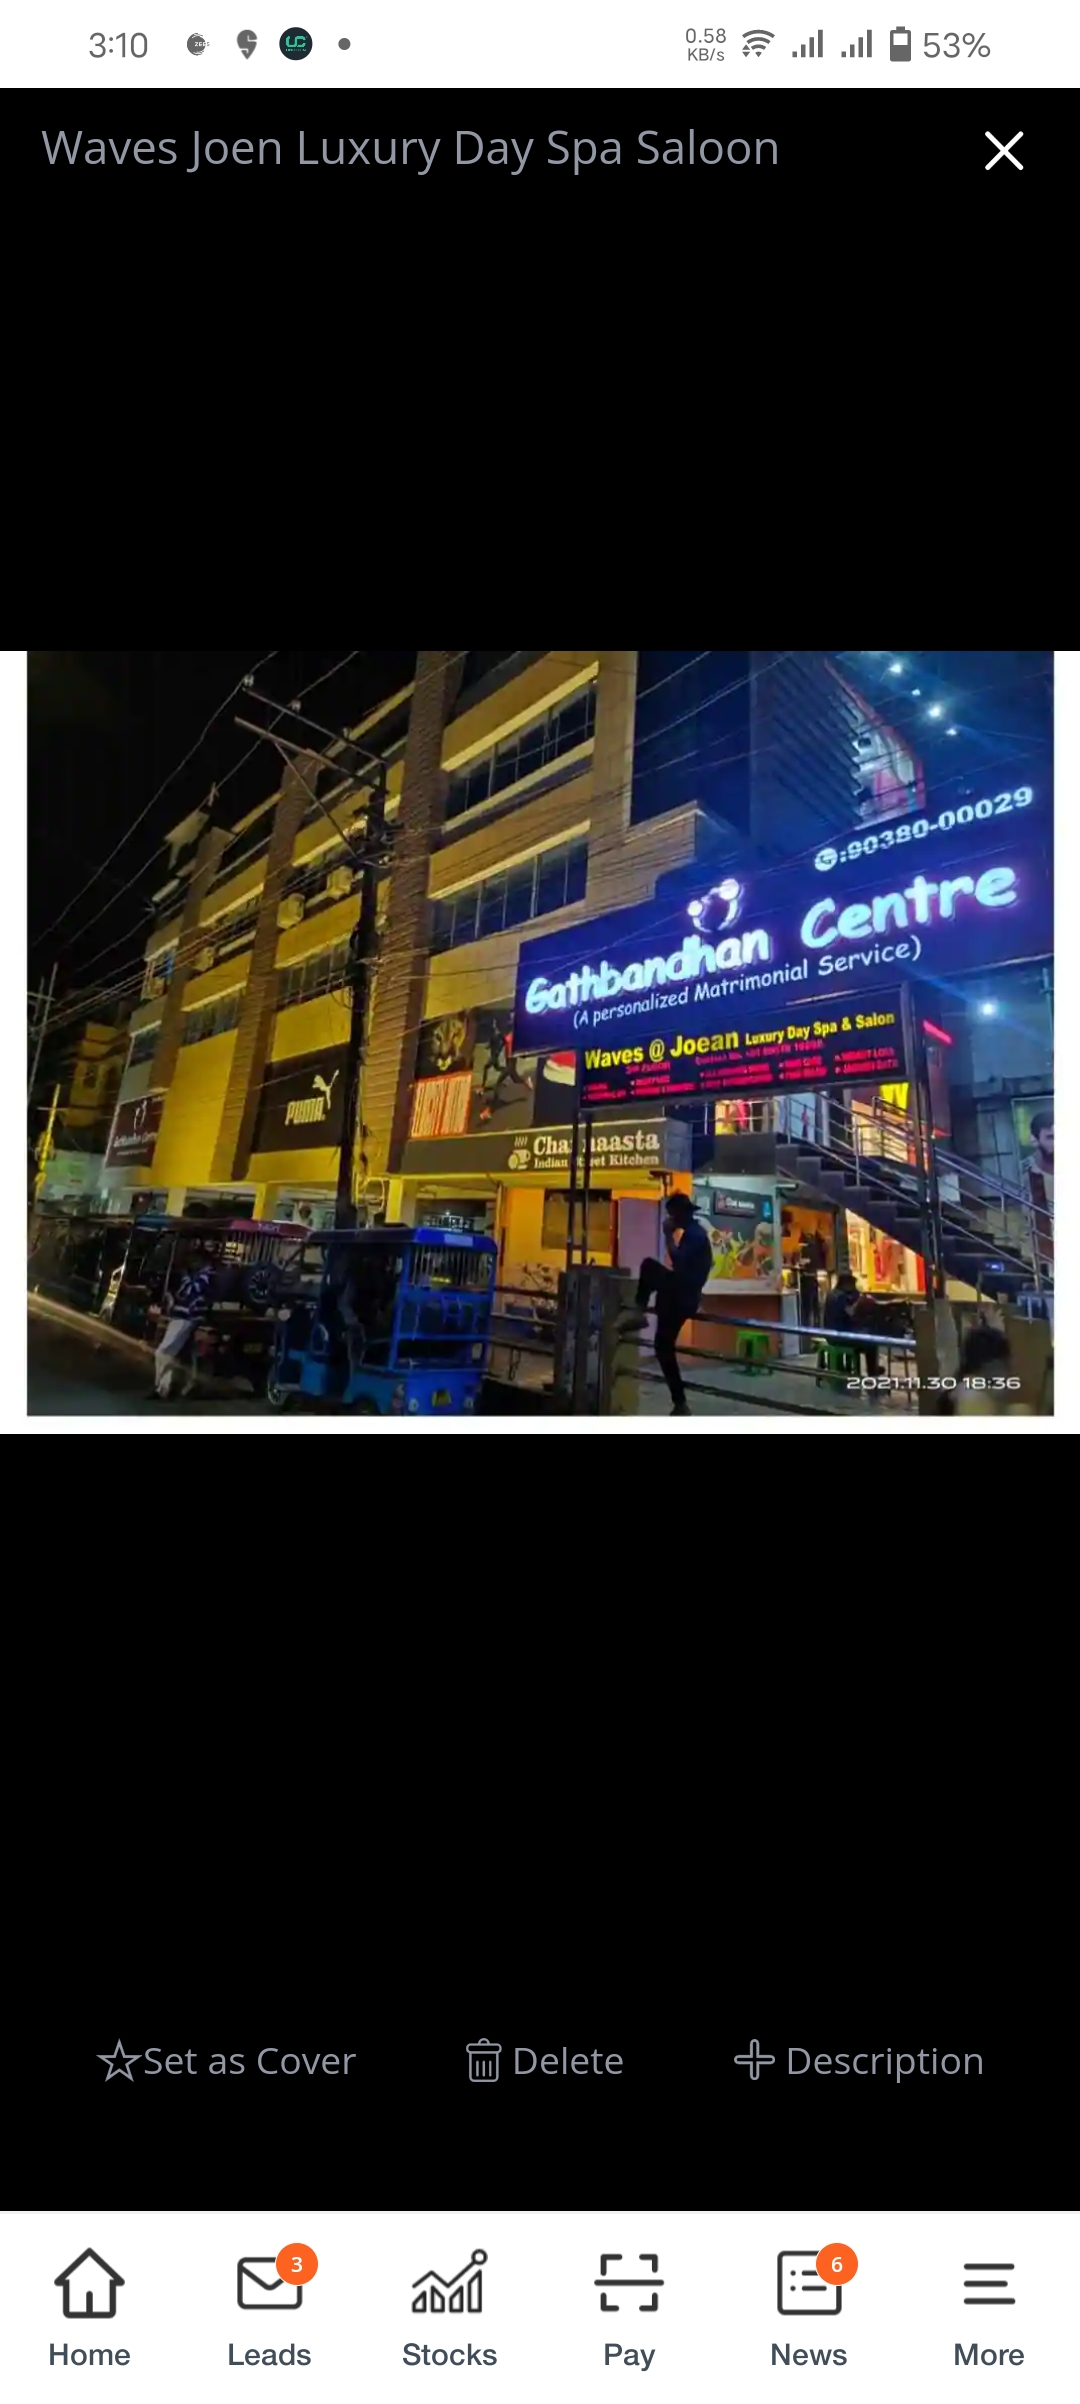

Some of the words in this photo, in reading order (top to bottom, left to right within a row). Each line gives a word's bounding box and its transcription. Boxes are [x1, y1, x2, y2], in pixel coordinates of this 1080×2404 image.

[89, 32, 147, 58] 3:10
[686, 27, 726, 43] 0.58
[923, 32, 990, 58] 53%
[688, 47, 725, 62] KB/s
[42, 131, 177, 165] Waves
[187, 131, 280, 174] Joen
[300, 131, 441, 175] Luxury
[457, 131, 534, 175] Day
[548, 130, 620, 175] Spa
[638, 129, 778, 165] Saloon
[525, 929, 770, 1013] Gathbandhan
[801, 867, 1017, 948] Centre
[573, 1011, 589, 1029] (A
[593, 988, 689, 1026] personalized
[694, 961, 808, 1002] Matrimonial
[817, 935, 922, 977] Service)
[585, 1047, 644, 1070] Waves
[649, 1038, 665, 1062] @
[669, 1031, 739, 1057] Joean
[745, 1029, 785, 1045] Luxury
[787, 1025, 811, 1041] Day
[813, 1021, 838, 1038] Spa
[841, 1017, 852, 1031] &
[855, 1012, 895, 1029] Salon
[534, 1157, 569, 1169] Indian
[609, 1154, 660, 1167] Kitchen
[145, 2048, 197, 2075] Set
[209, 2054, 245, 2075] as
[258, 2048, 357, 2075] Cover
[515, 2047, 624, 2075] Delete
[788, 2047, 983, 2083] Description
[292, 2257, 302, 2273] 3
[832, 2257, 843, 2273] 6
[50, 2343, 130, 2367] Home
[229, 2343, 311, 2367] Leads
[403, 2343, 497, 2367] Stocks
[605, 2343, 656, 2372] Pay
[772, 2343, 848, 2367] News
[955, 2343, 1025, 2367] More
